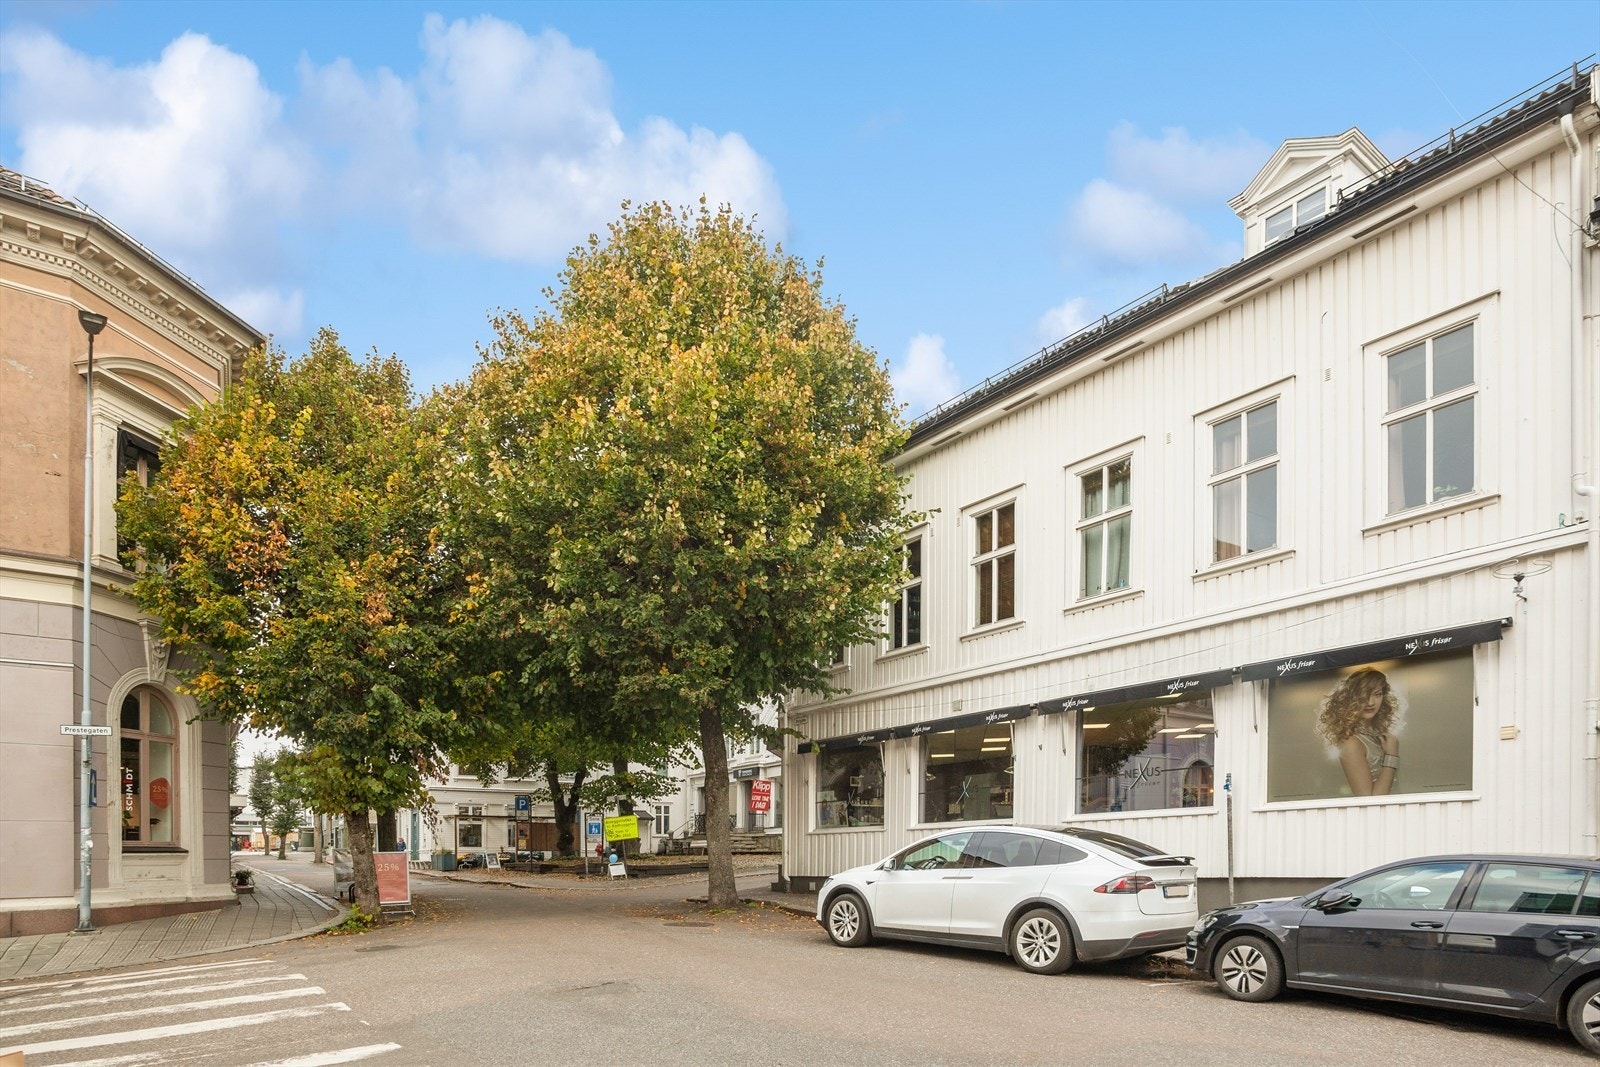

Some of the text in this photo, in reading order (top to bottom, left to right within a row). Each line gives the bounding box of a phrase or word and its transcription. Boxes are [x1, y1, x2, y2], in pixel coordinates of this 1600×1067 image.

[1277, 659, 1296, 676] NEXUS
[1124, 757, 1161, 790] NEXUS
[752, 780, 770, 792] Klipp
[519, 800, 527, 809] P
[377, 863, 400, 872] 25%
